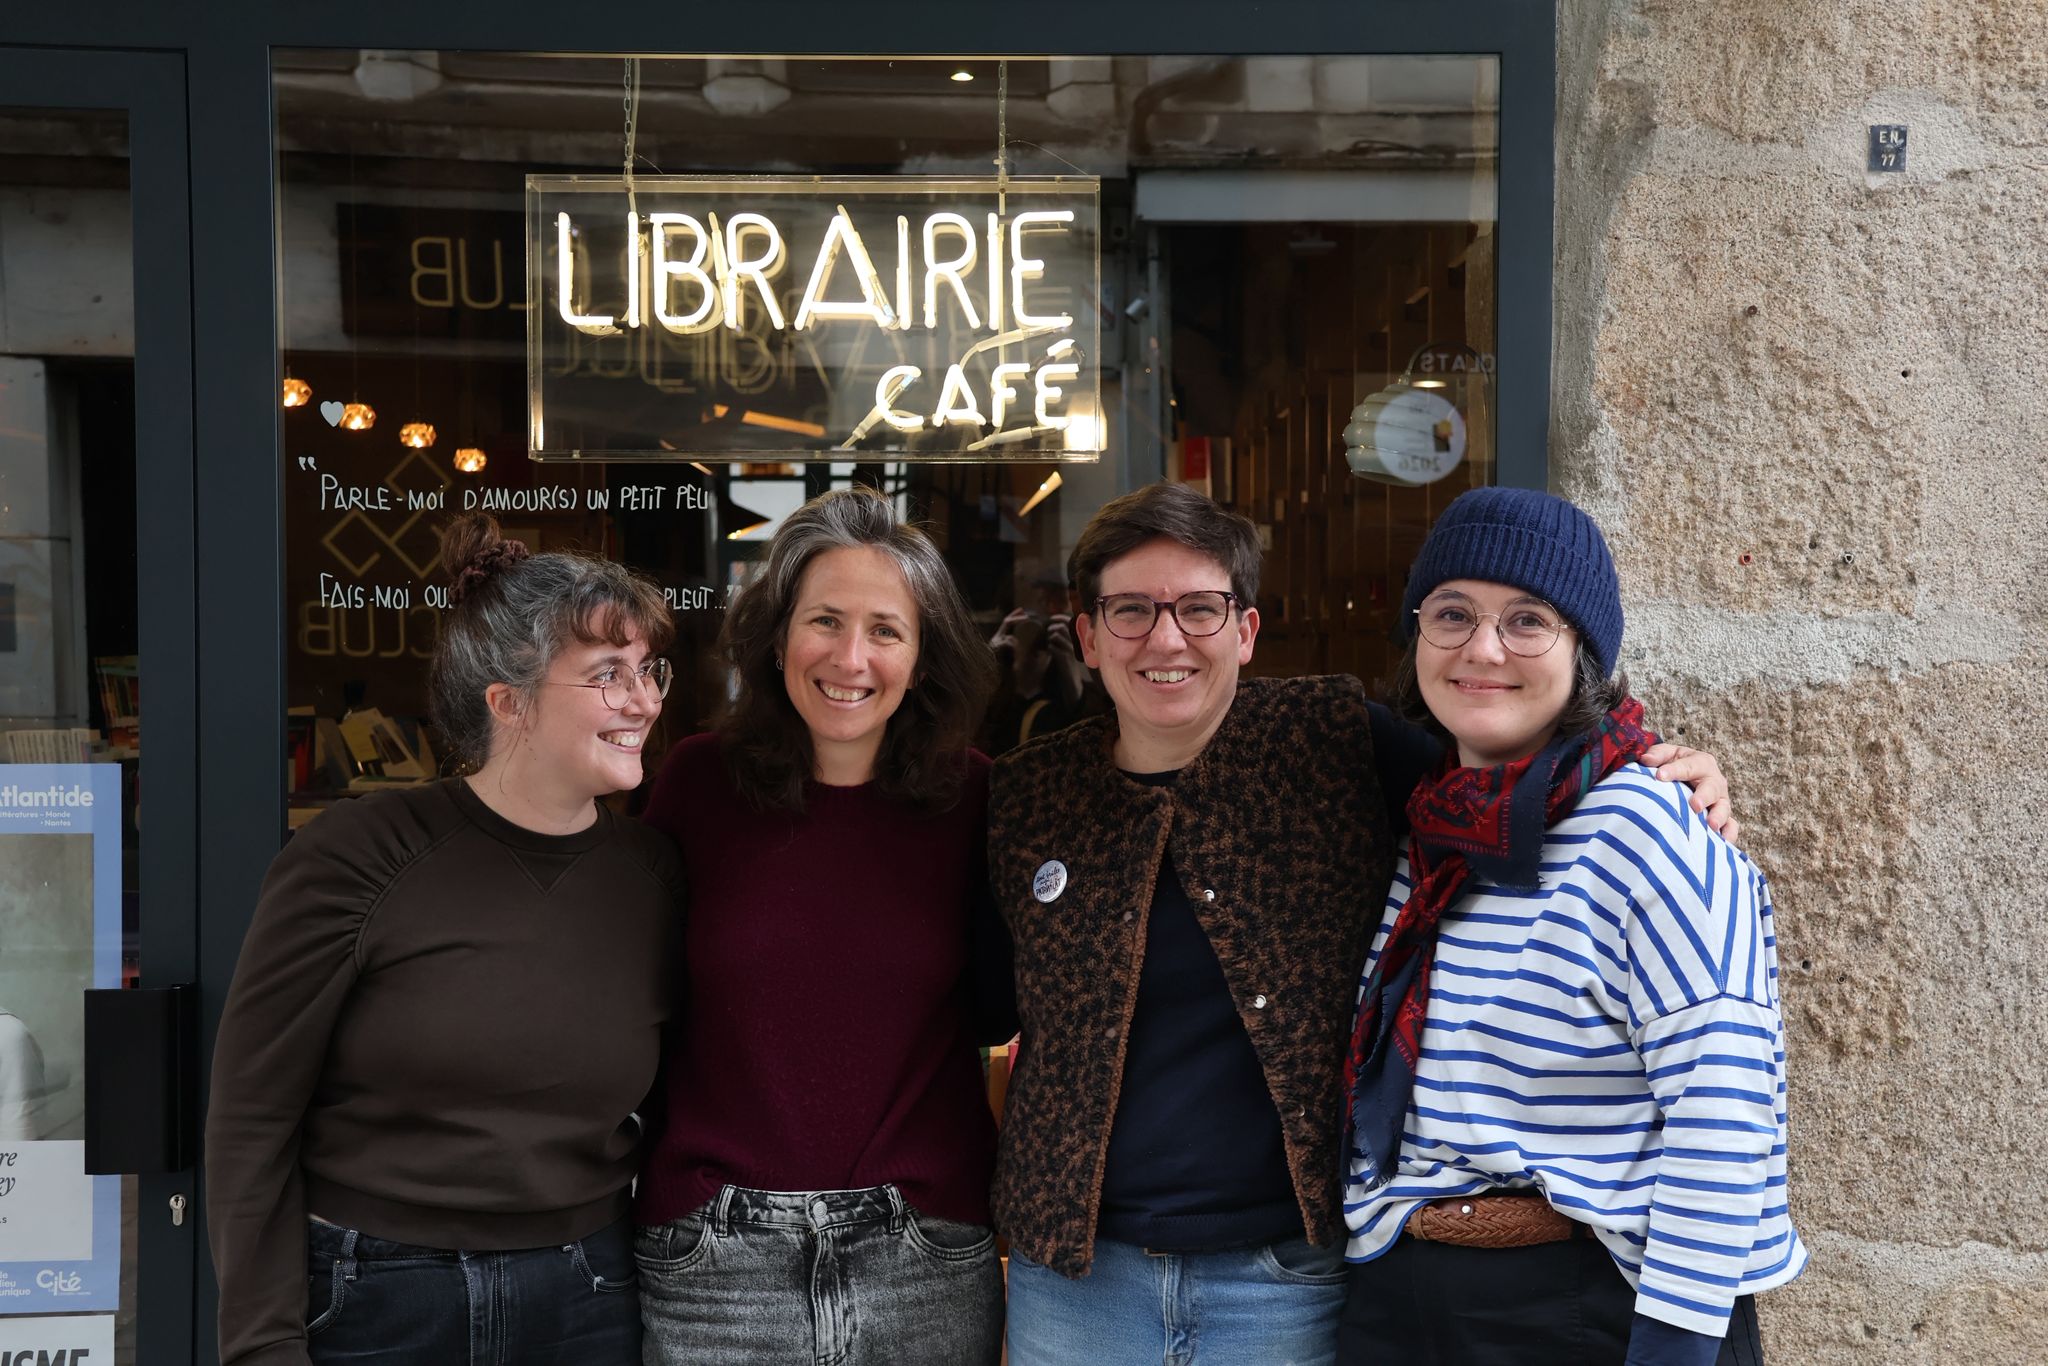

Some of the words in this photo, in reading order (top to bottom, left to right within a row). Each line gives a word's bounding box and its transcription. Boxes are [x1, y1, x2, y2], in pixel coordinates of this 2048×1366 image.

[1880, 131, 1899, 144] EN
[557, 209, 1075, 331] LIBRAIRIE
[875, 339, 1081, 429] CAFÉ
[587, 488, 610, 511] UN
[620, 485, 666, 511] PETIT
[676, 483, 708, 510] PEU
[320, 572, 411, 610] FAIS-MOI
[0, 784, 94, 807] tlantide
[44, 819, 72, 827] Nantes
[45, 810, 71, 819] Monde
[36, 1269, 82, 1297] Cité
